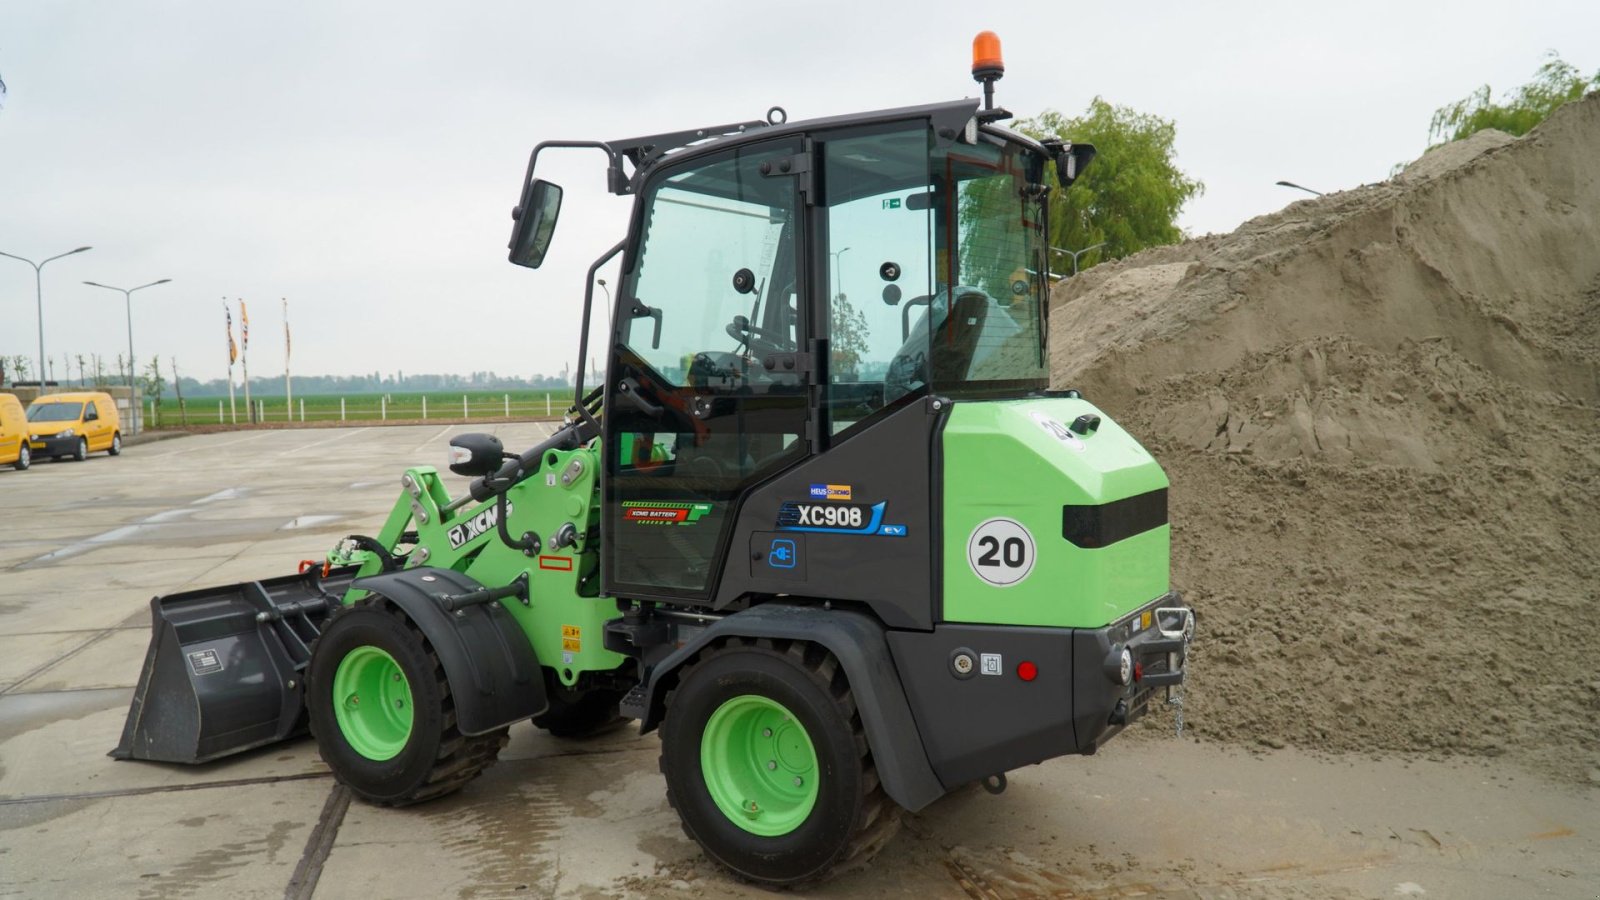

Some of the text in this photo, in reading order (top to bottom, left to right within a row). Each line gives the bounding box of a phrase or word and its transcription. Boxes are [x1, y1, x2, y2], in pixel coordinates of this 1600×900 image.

[1041, 420, 1073, 440] 20
[810, 487, 827, 496] HEUS
[798, 505, 861, 527] XC908
[977, 535, 1026, 568] 20
